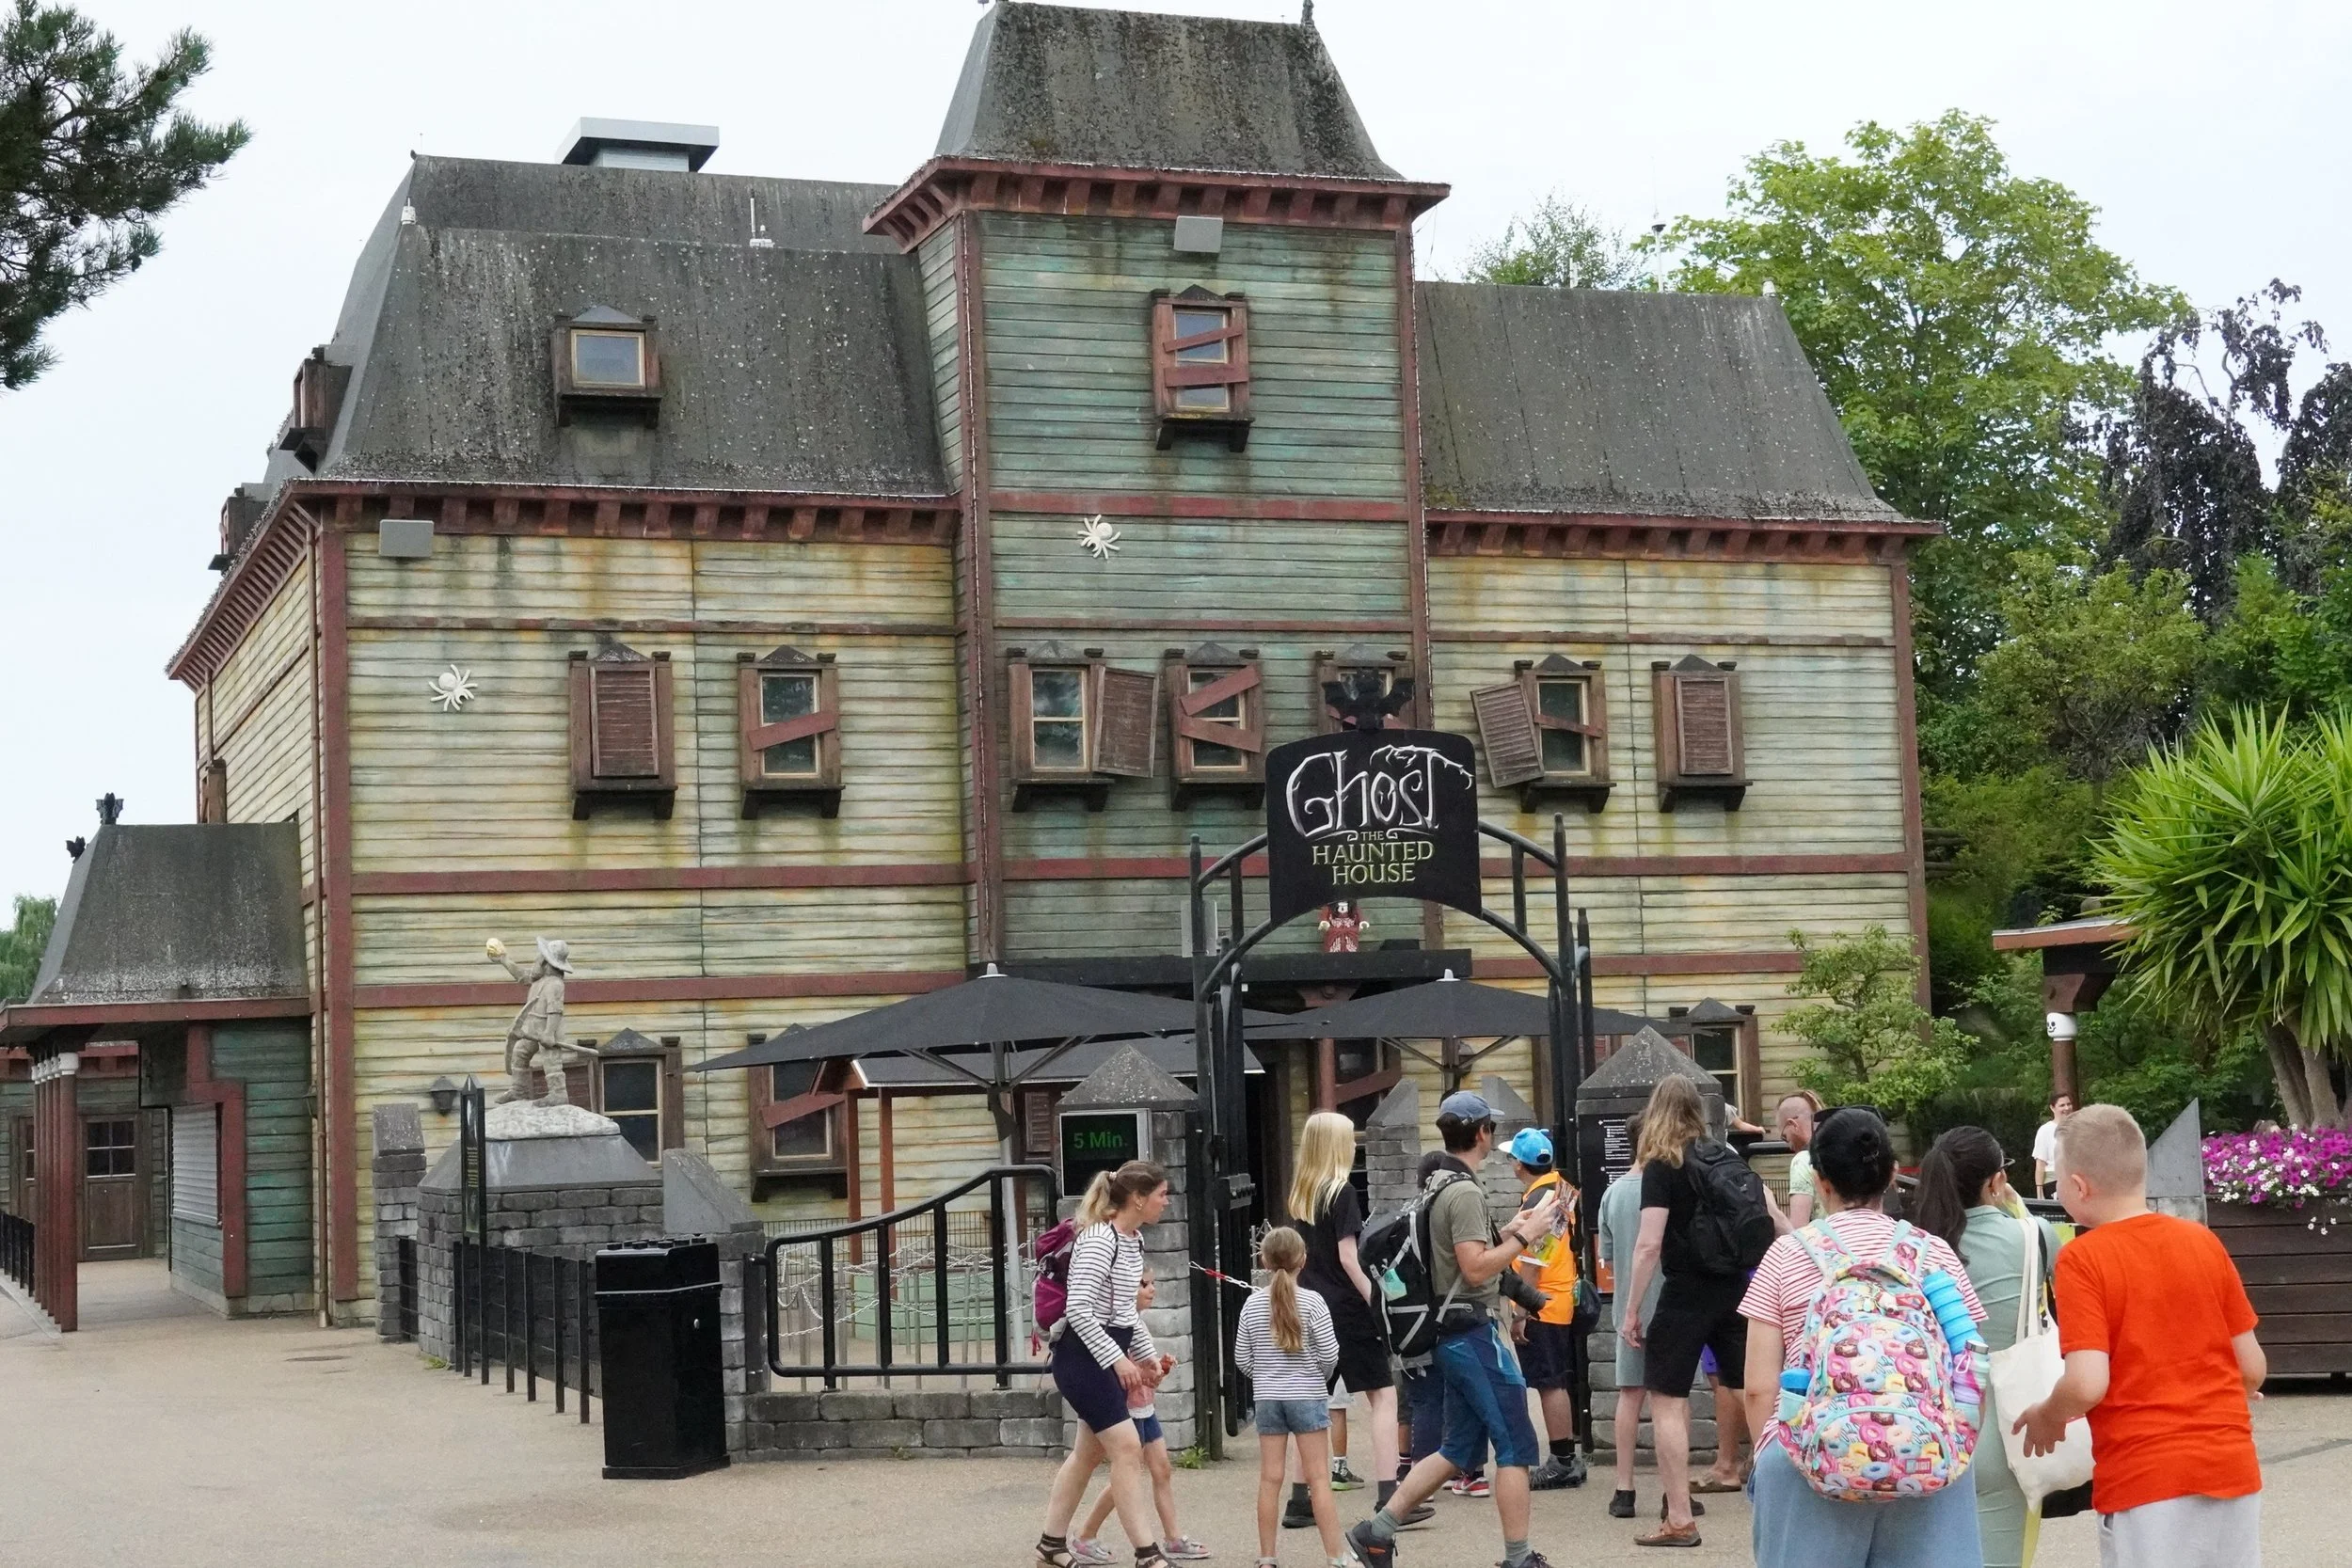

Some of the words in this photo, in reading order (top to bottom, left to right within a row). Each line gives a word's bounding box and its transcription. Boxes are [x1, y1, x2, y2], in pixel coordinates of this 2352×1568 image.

[1360, 831, 1384, 841] THE
[1312, 840, 1434, 865] HAUNTED
[1332, 863, 1416, 885] HOUSE
[1073, 1132, 1084, 1148] 5
